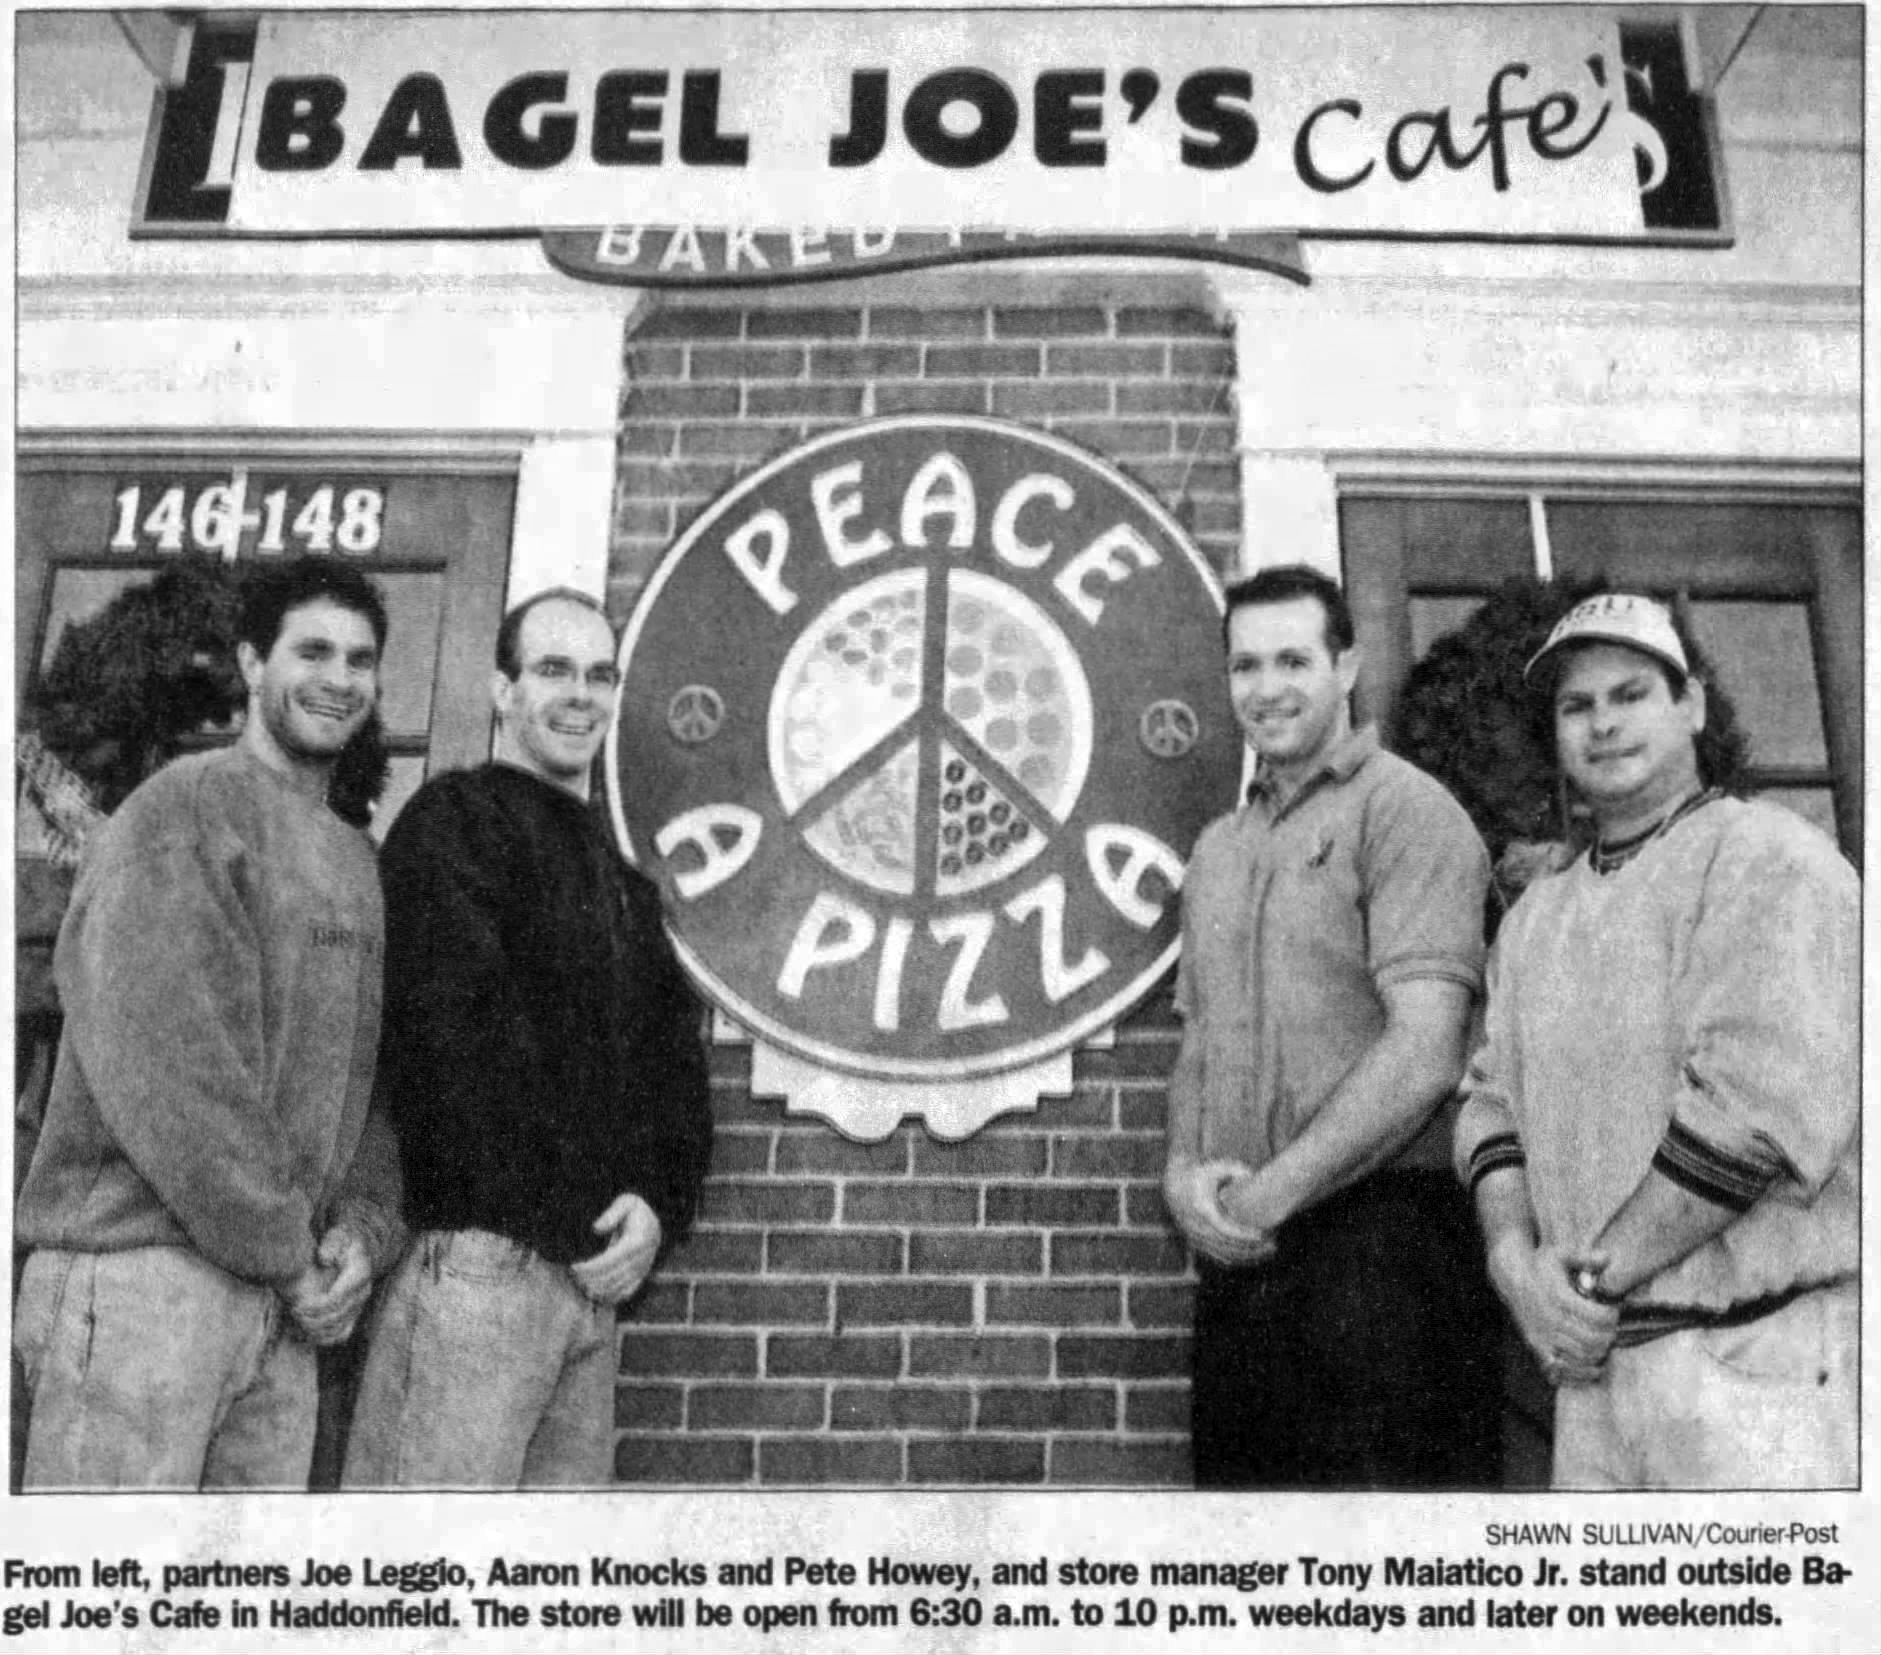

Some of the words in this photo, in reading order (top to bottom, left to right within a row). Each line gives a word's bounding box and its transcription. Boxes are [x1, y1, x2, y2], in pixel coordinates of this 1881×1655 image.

[254, 68, 749, 172] BAGEL
[828, 66, 1260, 171] JOE'S
[110, 485, 384, 555] 146-148
[723, 452, 1163, 626] PEACE
[654, 802, 764, 899] A
[776, 822, 1187, 1032] PIZZA
